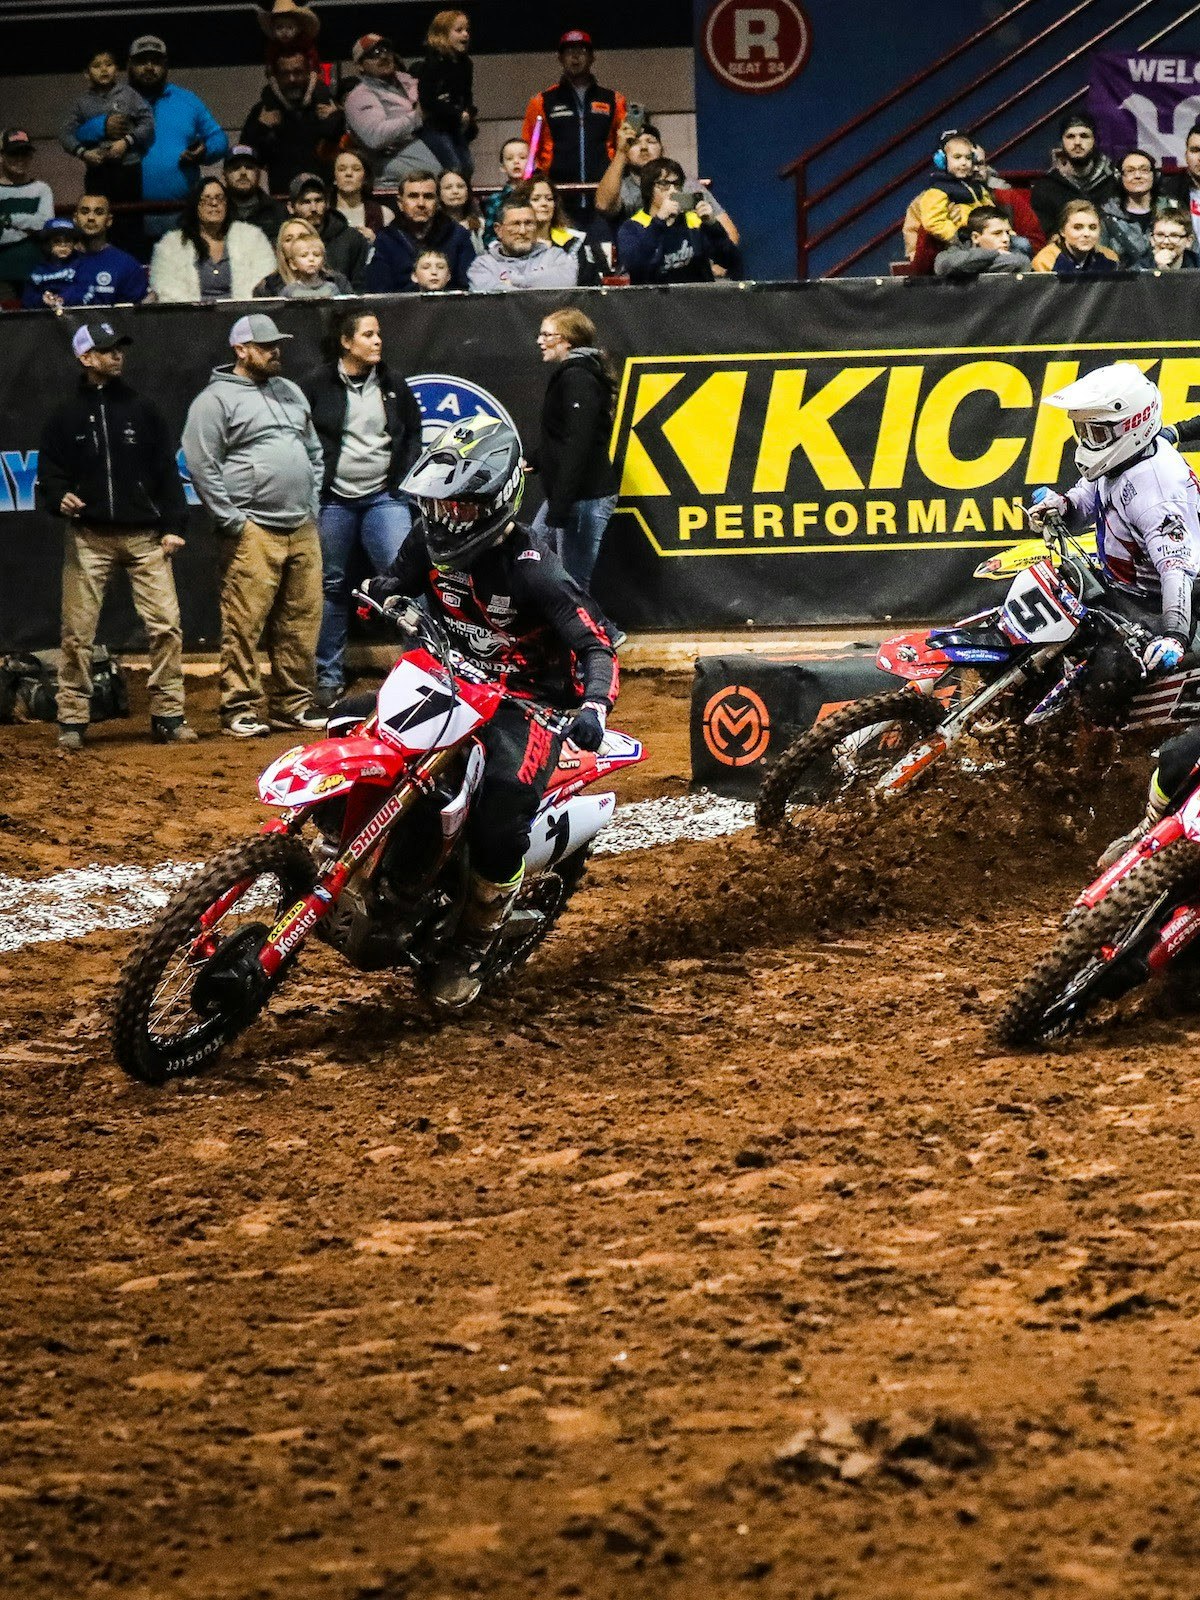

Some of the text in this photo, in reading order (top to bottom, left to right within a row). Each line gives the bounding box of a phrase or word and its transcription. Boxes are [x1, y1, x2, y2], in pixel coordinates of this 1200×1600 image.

[734, 9, 780, 59] R
[729, 61, 761, 75] SEAT
[678, 496, 1024, 542] PERFORMAN
[443, 614, 493, 639] PHOENIX
[1007, 585, 1062, 634] 5
[384, 686, 461, 733] 7
[351, 796, 402, 859] SHOWA
[268, 901, 305, 943] ACERBIS
[274, 909, 318, 960] Hoosier
